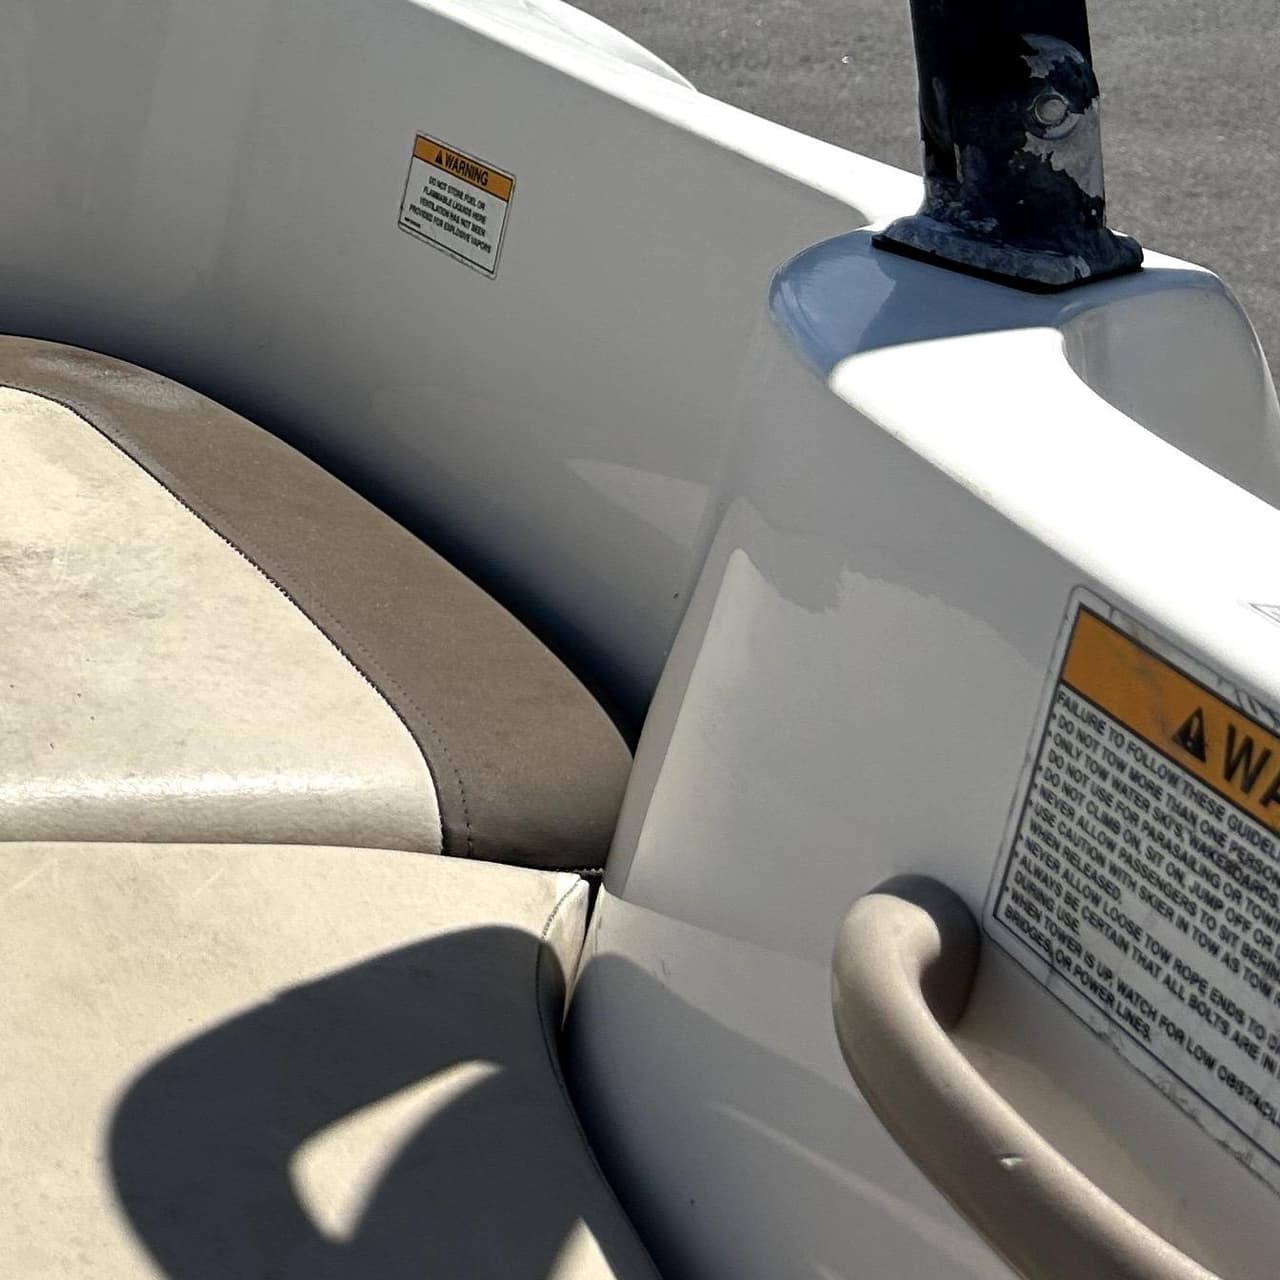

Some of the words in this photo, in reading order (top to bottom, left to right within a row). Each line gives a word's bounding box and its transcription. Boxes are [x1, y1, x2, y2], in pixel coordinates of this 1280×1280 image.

[444, 153, 490, 187] WARNING
[1047, 748, 1065, 771] DO
[1065, 762, 1090, 790] NOT
[1090, 781, 1115, 808] USE
[1114, 799, 1140, 828] FOR
[1140, 818, 1222, 890] PARASAILING
[1222, 880, 1243, 905] OR
[1052, 732, 1083, 763] ONLY
[1083, 754, 1110, 783] TOW
[1110, 774, 1151, 813] WATER
[1056, 691, 1106, 736] FAILURE
[1107, 727, 1125, 749] TO
[1126, 741, 1180, 789] FOLLOW
[1181, 780, 1225, 821] THESE
[1057, 715, 1075, 736] DO
[1075, 727, 1101, 755] NOT
[1100, 746, 1128, 775] TOW
[1127, 766, 1164, 801] MORE
[1165, 793, 1198, 826] THAN
[1199, 818, 1228, 848] ONE
[1014, 870, 1056, 913] DURING
[1056, 905, 1082, 936] USE.
[1028, 819, 1061, 854] WHEN
[1062, 845, 1124, 904] RELEASED.
[1033, 802, 1057, 829] USE
[1057, 820, 1107, 868] CAUTION
[1108, 860, 1138, 892] WITH
[1138, 883, 1175, 922] SKIER
[1176, 913, 1190, 934] IN
[1192, 925, 1219, 957] TOW
[1221, 948, 1242, 974] AS
[1243, 965, 1272, 999] TOW
[1038, 785, 1076, 822] NEVER
[1076, 814, 1117, 854] ALLOW
[1118, 846, 1198, 917] PASSENGERS
[1199, 908, 1218, 932] TO
[1218, 923, 1240, 950] SIT
[1043, 766, 1061, 789] DO
[1061, 780, 1086, 808] NOT
[1085, 798, 1122, 836] CLIMB
[1122, 826, 1144, 854] ON,
[1144, 843, 1165, 869] SIT
[1164, 859, 1188, 887] ON,
[1189, 877, 1225, 915] JUMP
[1225, 905, 1253, 936] OFF
[1252, 926, 1274, 952] OR
[1010, 888, 1042, 925] WHEN
[1042, 916, 1082, 958] TOWER
[1084, 950, 1096, 970] IS
[1116, 978, 1157, 1022] WATCH
[1158, 1013, 1185, 1045] FOR
[1186, 1036, 1216, 1072] LOW
[1217, 1063, 1280, 1128] OBSTACL
[1019, 854, 1063, 899] ALWAYS
[1063, 890, 1081, 913] BE
[1080, 904, 1130, 954] CERTAIN
[1130, 944, 1162, 981] THAT
[1162, 970, 1188, 1002] ALL
[1187, 991, 1231, 1037] BOLTS
[1230, 1026, 1260, 1061] ARE
[1260, 1051, 1278, 1076] IN
[1024, 836, 1061, 875] NEVER
[1062, 867, 1103, 909] ALLOW
[1103, 900, 1143, 942] LOOSE
[1143, 932, 1172, 965] TOW
[1173, 956, 1209, 995] ROPE
[1209, 985, 1247, 1026] ENDS
[1247, 1016, 1267, 1042] TO
[1055, 948, 1073, 972] OR
[1073, 963, 1115, 1009] POWER
